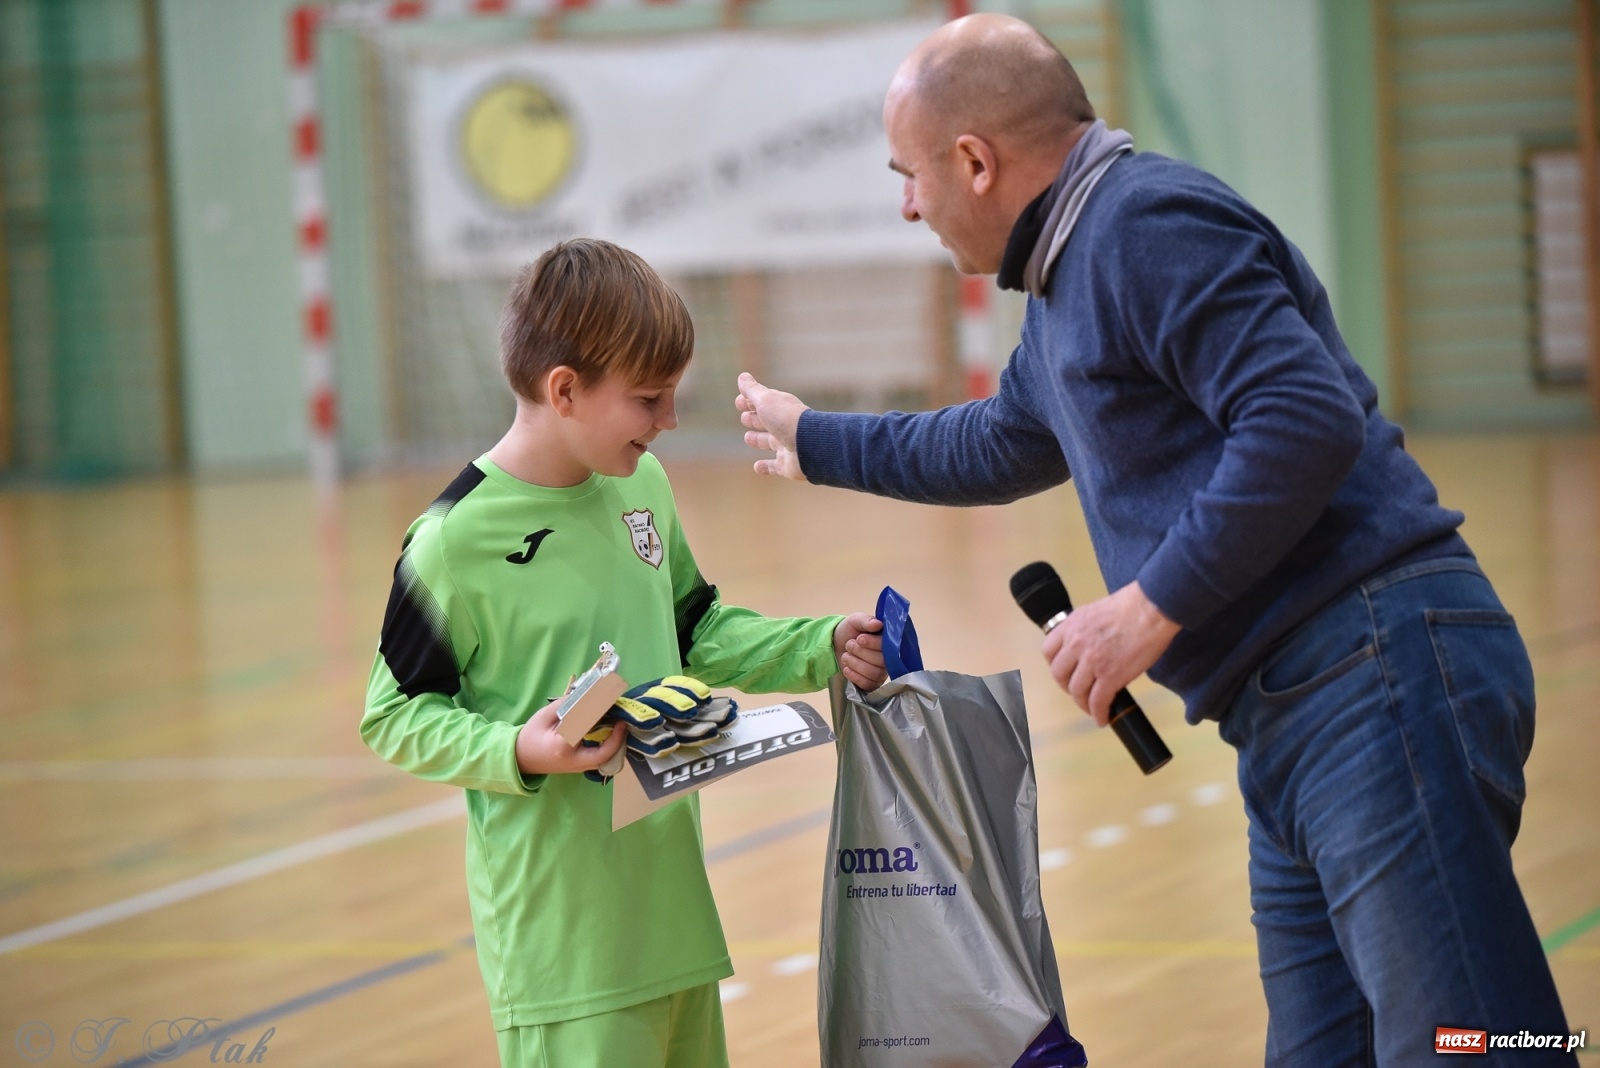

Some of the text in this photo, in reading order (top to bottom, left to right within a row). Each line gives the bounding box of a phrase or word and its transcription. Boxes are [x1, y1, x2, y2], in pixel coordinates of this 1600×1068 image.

[662, 729, 813, 789] DYPLOM
[846, 883, 957, 899] Entrena tu libertad
[857, 1035, 930, 1050] joma-sport.com
